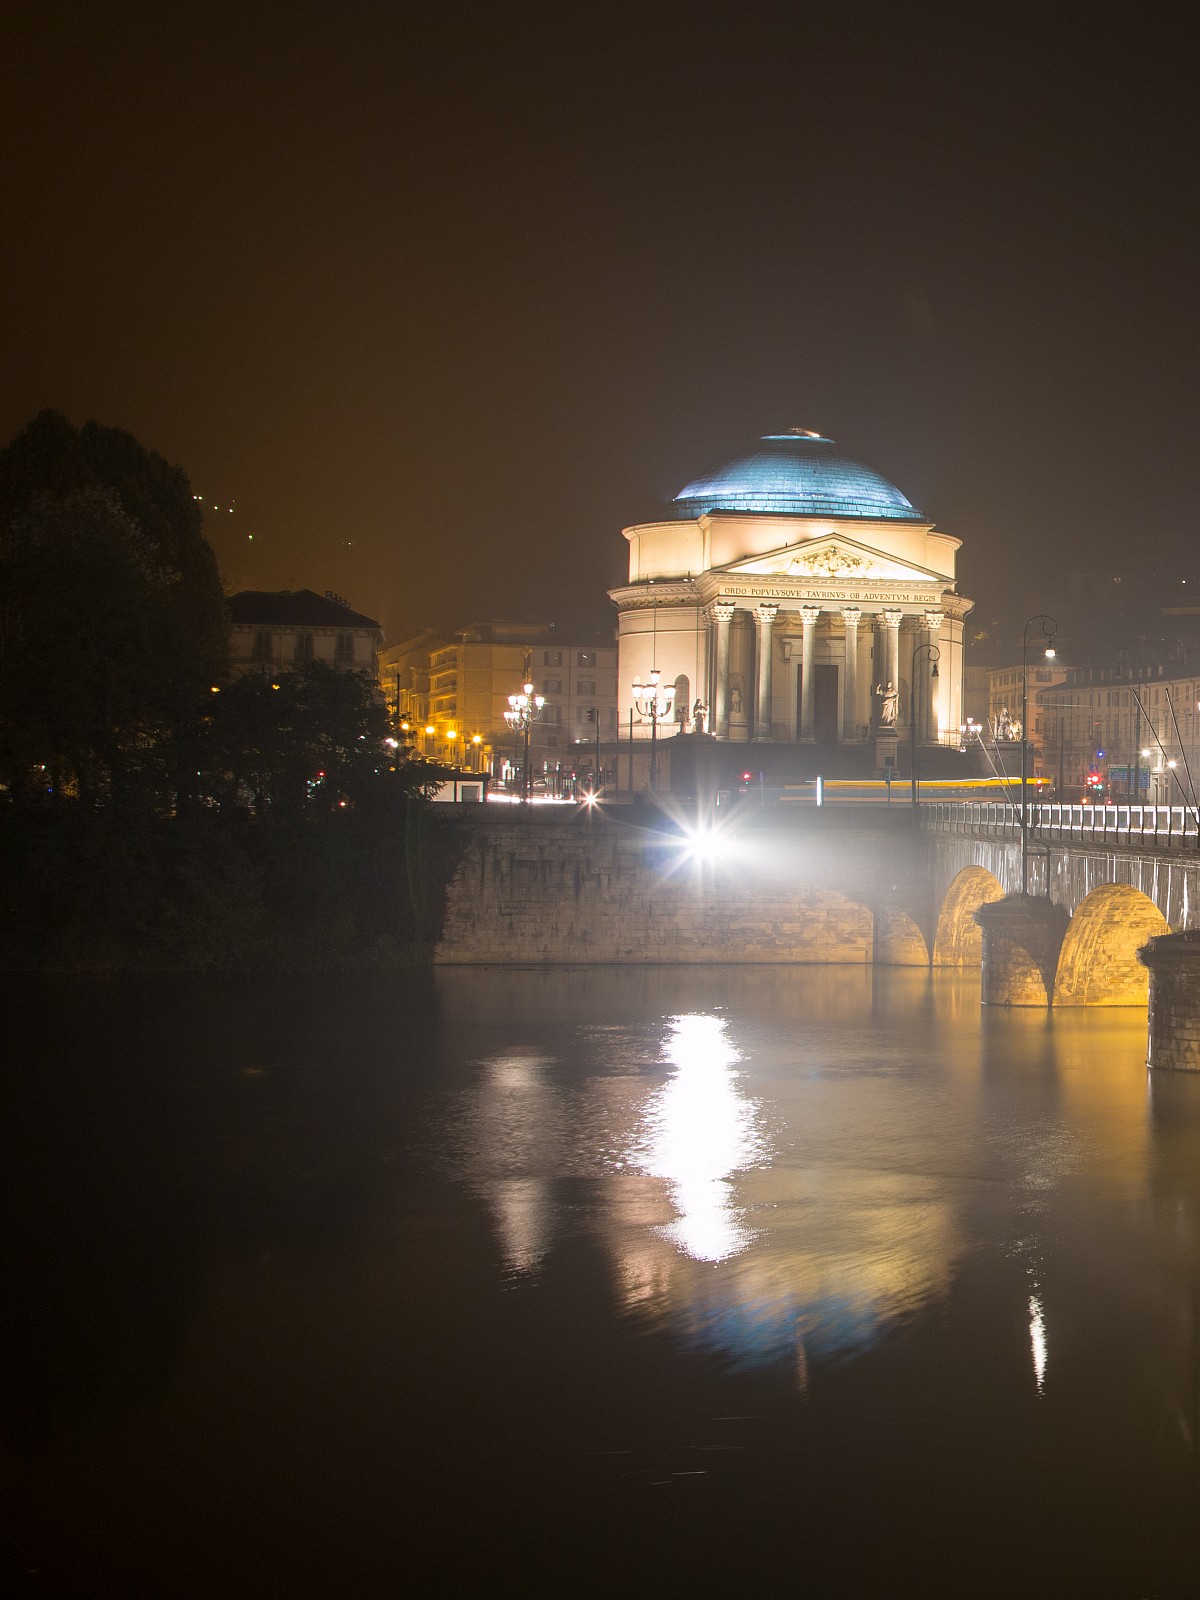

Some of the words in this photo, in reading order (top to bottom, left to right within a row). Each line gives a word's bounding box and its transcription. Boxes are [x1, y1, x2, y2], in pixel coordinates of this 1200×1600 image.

[724, 587, 747, 595] ORDO
[751, 588, 802, 597] POPVLVSQVE
[806, 590, 846, 599] TAVRINVS
[863, 593, 910, 601] ADVENTVM
[913, 594, 936, 602] REGIS
